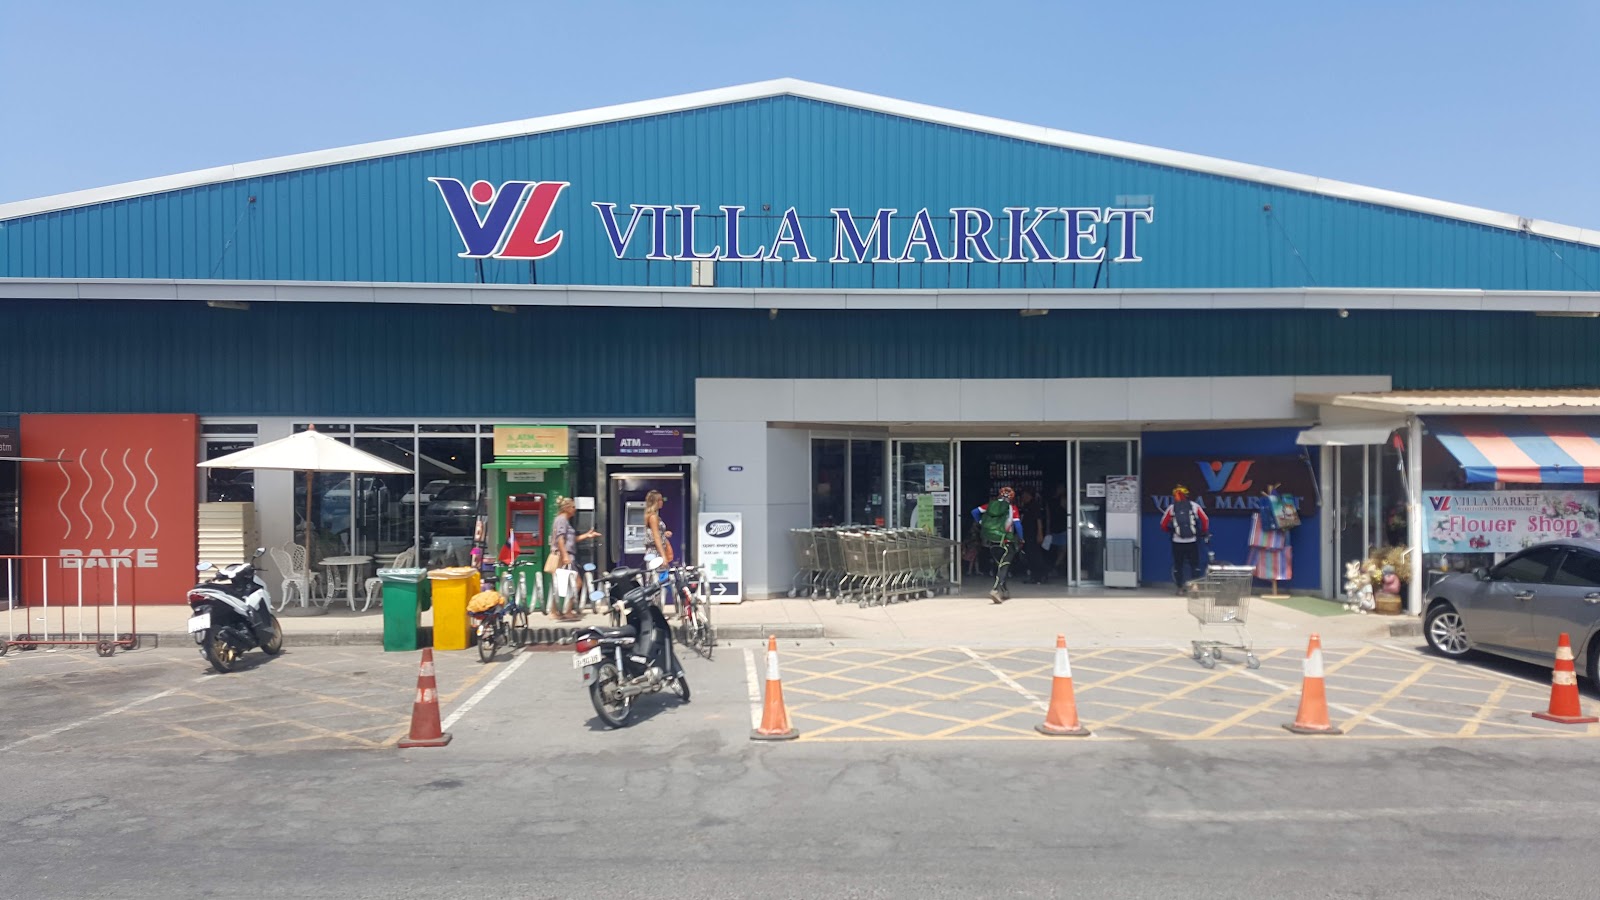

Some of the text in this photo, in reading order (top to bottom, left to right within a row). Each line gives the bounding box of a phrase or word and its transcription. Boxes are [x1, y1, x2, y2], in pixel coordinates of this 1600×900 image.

[591, 202, 1154, 263] VILLA MARKET
[620, 438, 641, 447] ATM
[1151, 495, 1207, 509] VIA
[1215, 495, 1304, 510] MART
[1454, 496, 1540, 506] VILLA MARKET
[1528, 515, 1579, 537] Shop
[59, 548, 158, 569] BAKE
